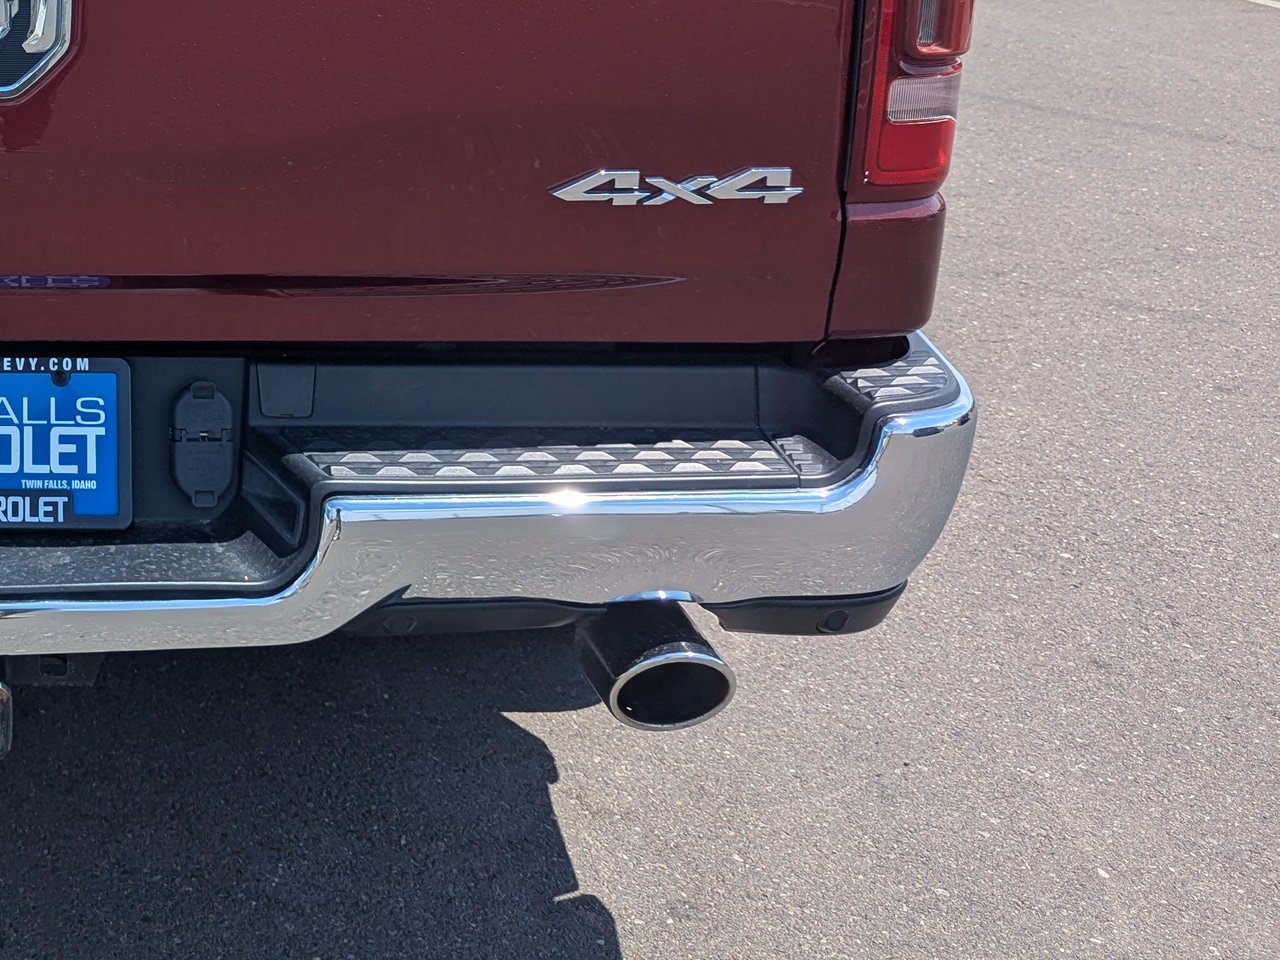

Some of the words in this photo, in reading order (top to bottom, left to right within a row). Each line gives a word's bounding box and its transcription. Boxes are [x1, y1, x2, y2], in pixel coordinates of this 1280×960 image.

[21, 479, 43, 489] TWIN
[44, 479, 70, 490] FALLS,
[72, 480, 97, 490] IDAHO
